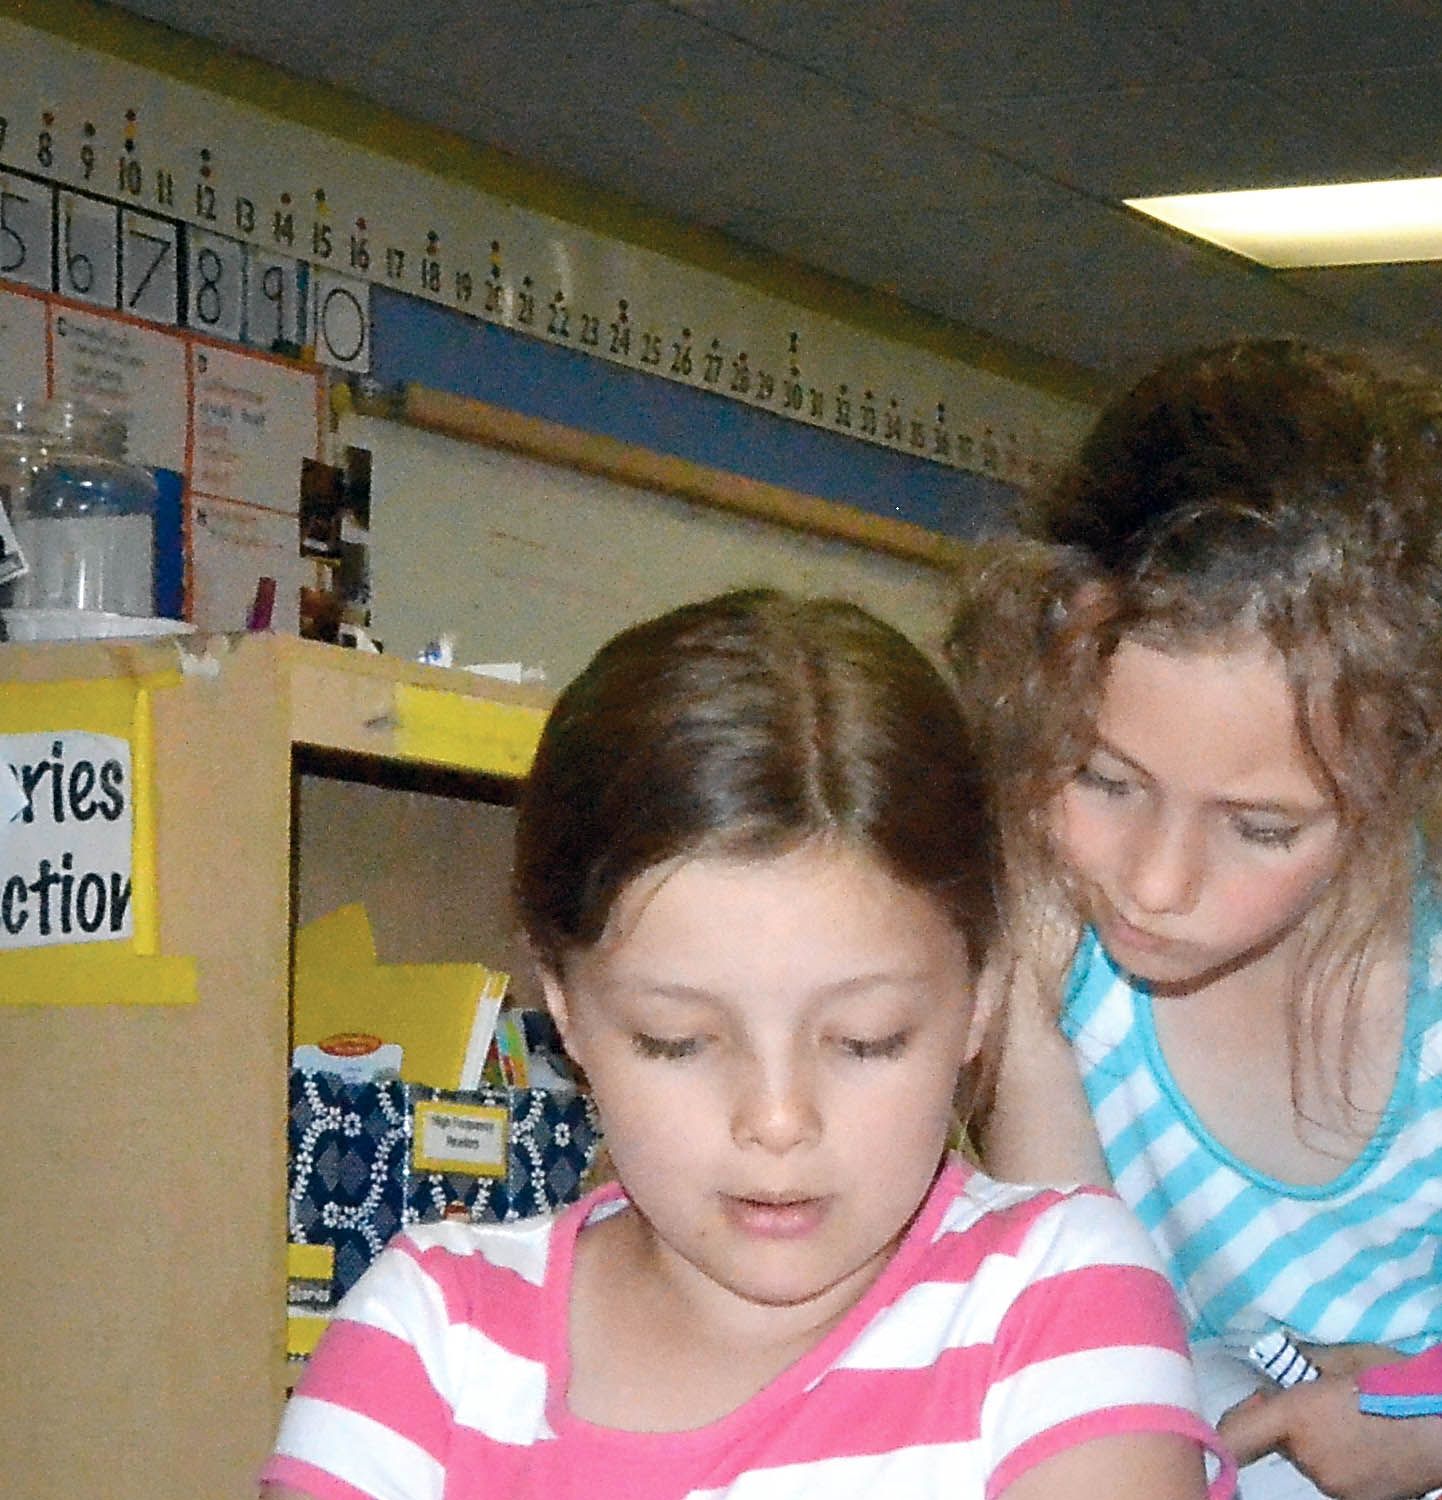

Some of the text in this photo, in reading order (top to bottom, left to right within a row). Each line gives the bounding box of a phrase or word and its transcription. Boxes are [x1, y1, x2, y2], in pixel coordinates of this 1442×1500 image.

[0, 191, 29, 272] 5
[64, 212, 94, 295] 6
[128, 229, 173, 309] 7
[197, 248, 223, 325] 8
[262, 266, 285, 341] 9
[38, 132, 53, 167] 8
[81, 145, 94, 179] 9
[118, 156, 142, 196] 10
[156, 169, 173, 205] 11
[196, 183, 216, 221] 12
[235, 197, 255, 233] 13
[273, 212, 295, 246] 14
[313, 223, 332, 258] 15
[350, 235, 370, 272] 16
[386, 247, 404, 278] 17
[421, 259, 441, 292] 18
[456, 271, 472, 301] 19
[518, 292, 534, 324] 21
[547, 303, 569, 337] 22
[581, 313, 598, 345] 23
[609, 323, 630, 355] 24
[641, 332, 660, 365] 25
[671, 341, 692, 374] 26
[9, 741, 124, 823] ries
